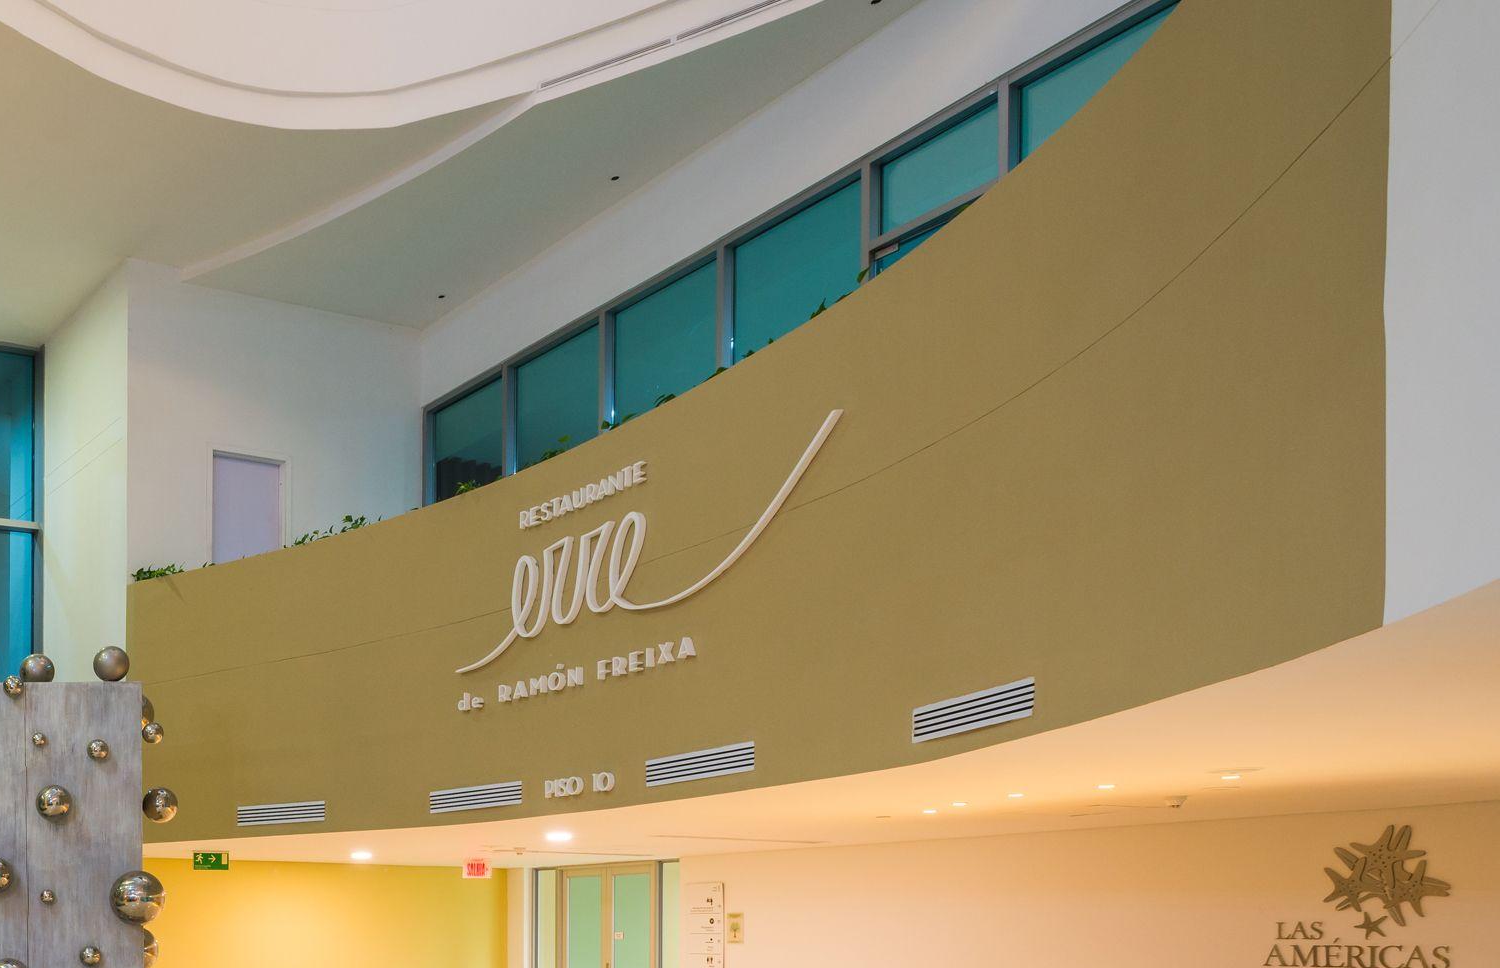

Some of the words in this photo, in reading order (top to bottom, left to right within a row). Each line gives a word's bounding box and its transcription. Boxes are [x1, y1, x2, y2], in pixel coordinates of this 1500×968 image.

[519, 460, 648, 530] RESTAURANTE
[457, 692, 485, 711] de
[498, 663, 584, 702] RAMÓN
[596, 636, 697, 680] FREIXA
[544, 776, 585, 799] PISO
[592, 771, 615, 793] 10
[1276, 921, 1323, 940] LAS
